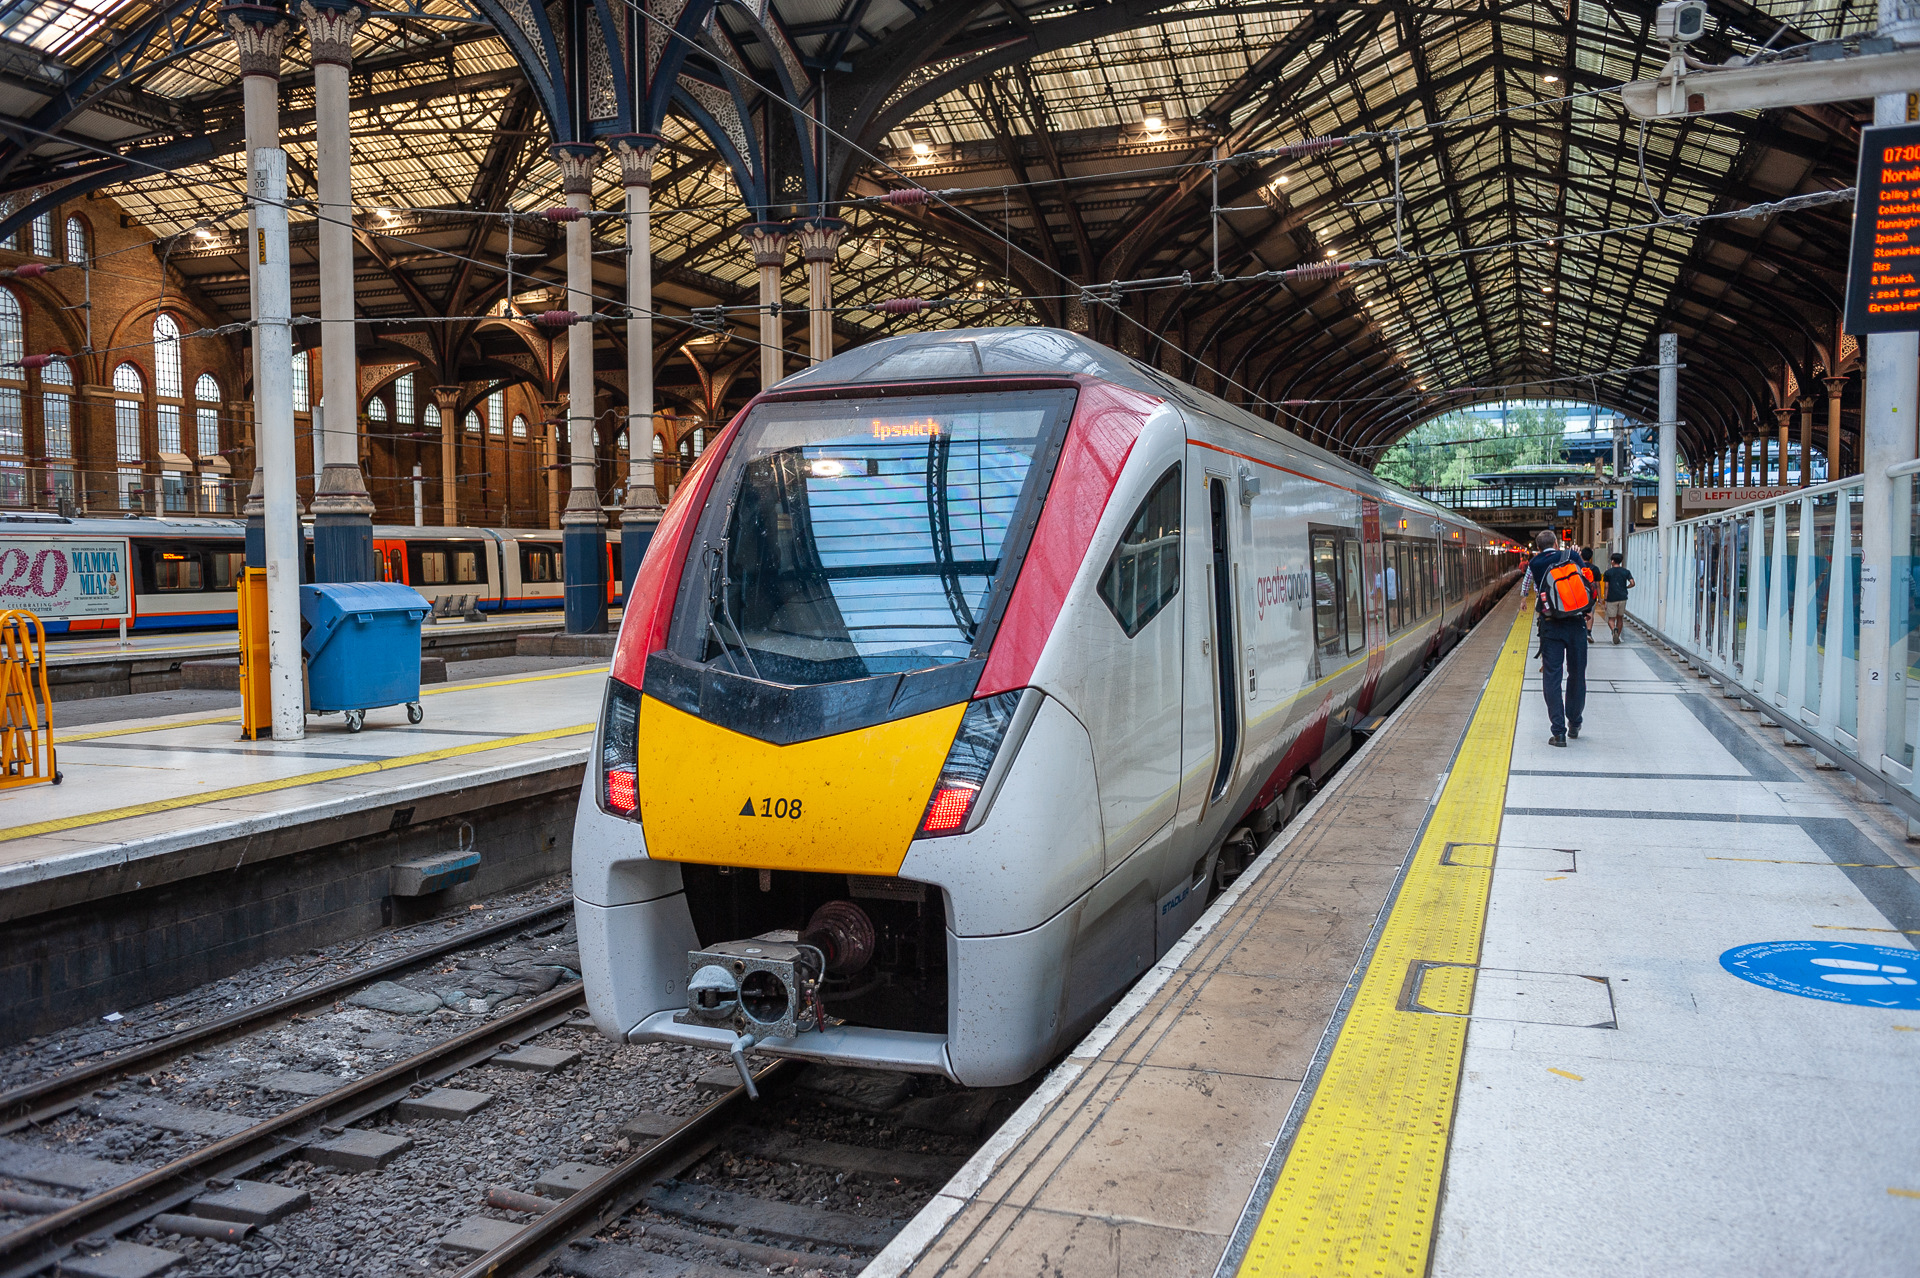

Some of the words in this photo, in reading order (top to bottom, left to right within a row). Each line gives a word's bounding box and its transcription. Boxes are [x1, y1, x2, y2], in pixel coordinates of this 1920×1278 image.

[1883, 144, 1920, 163] 07:00
[1881, 166, 1920, 184] Norwi
[1879, 189, 1910, 201] Calling
[1875, 231, 1909, 245] Ipswich
[1872, 261, 1891, 272] Diss
[1871, 276, 1879, 285] &
[1876, 288, 1900, 299] seat
[1868, 301, 1920, 314] Greater
[872, 418, 940, 441] Ipswich
[1705, 491, 1732, 500] LEFT
[71, 552, 120, 573] MAMMA
[0, 548, 69, 598] 20
[79, 573, 107, 595] MIA!
[1871, 671, 1879, 681] 2
[760, 797, 802, 819] 108
[1162, 887, 1189, 916] STADLER
[1760, 972, 1801, 987] Please
[1803, 986, 1846, 998] keep
[1778, 985, 1852, 1002] distance
